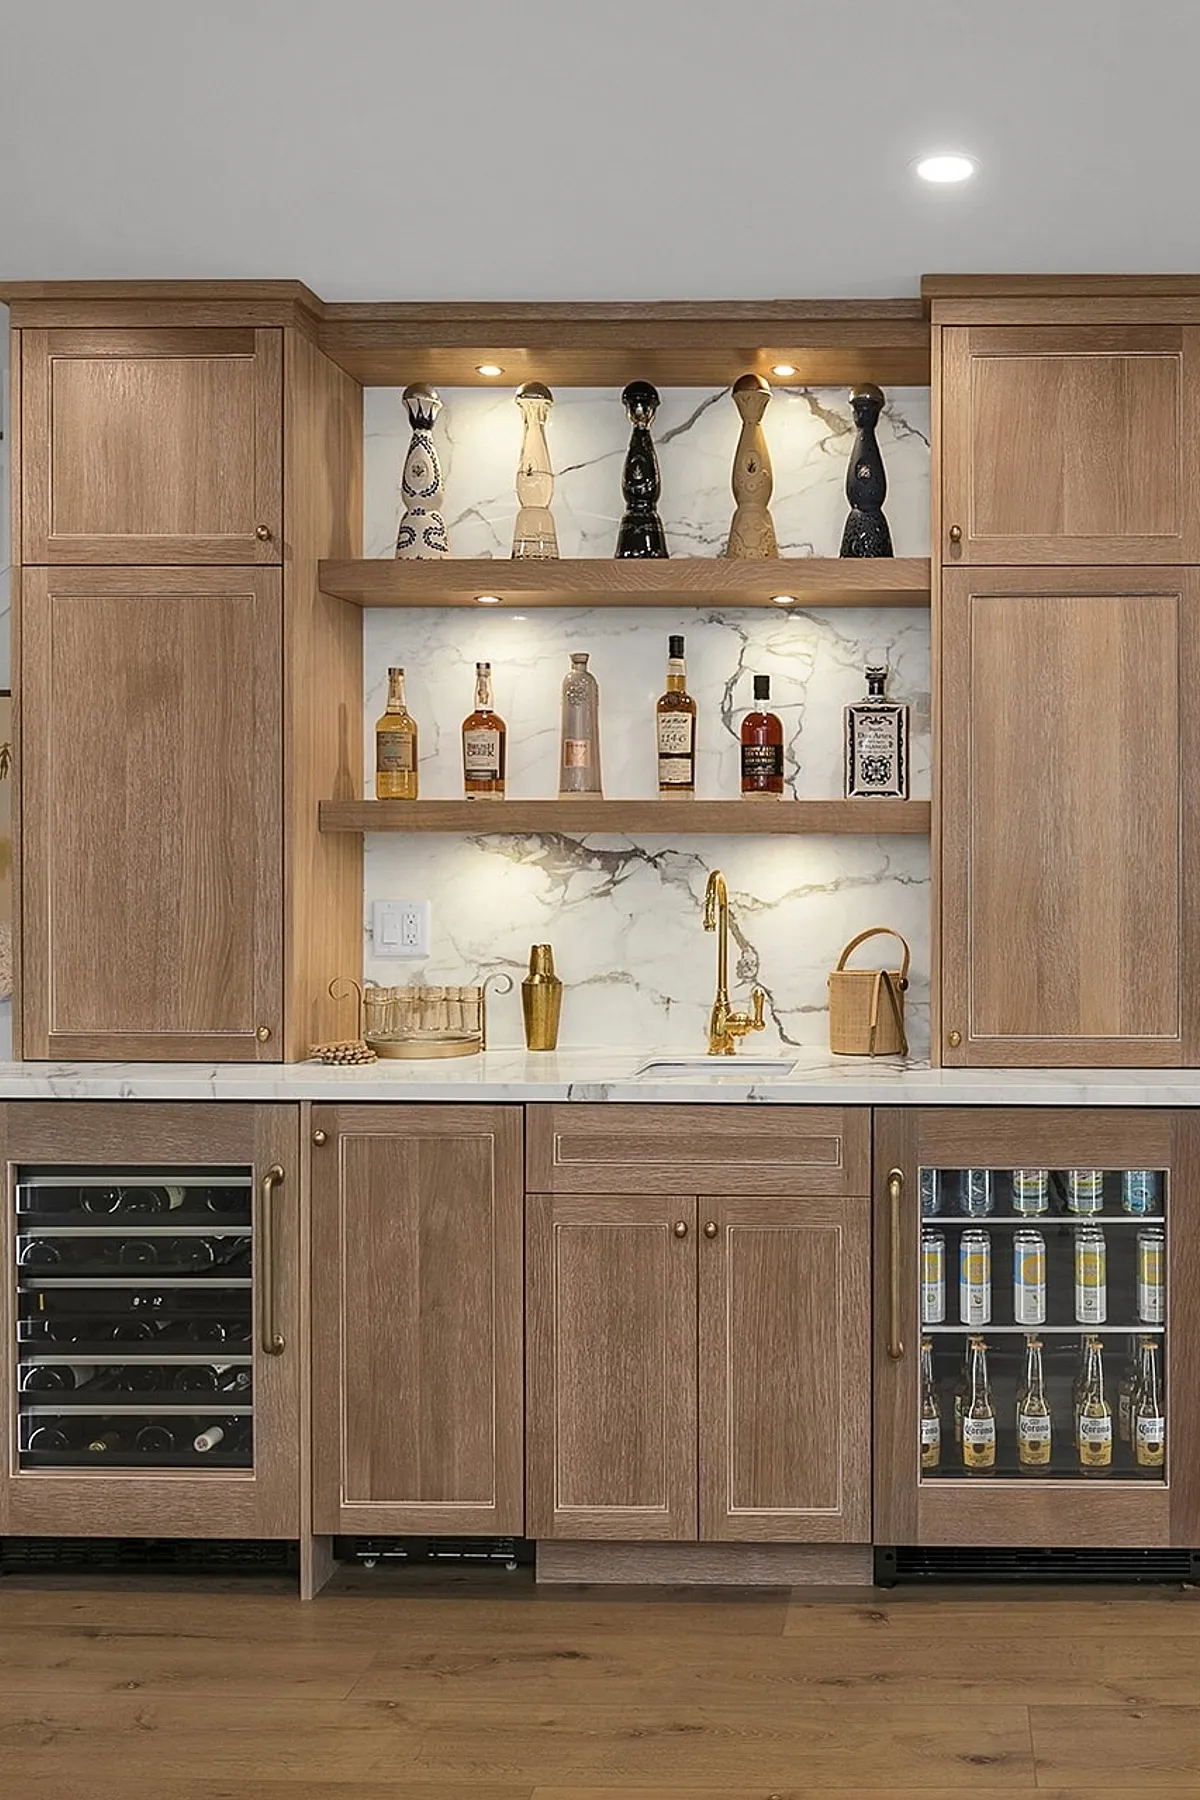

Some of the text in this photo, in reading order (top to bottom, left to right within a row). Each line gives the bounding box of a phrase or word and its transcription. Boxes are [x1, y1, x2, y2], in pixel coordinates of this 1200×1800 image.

[965, 1423, 994, 1435] Corona
[1020, 1422, 1049, 1434] Corona
[1081, 1422, 1110, 1435] Corona
